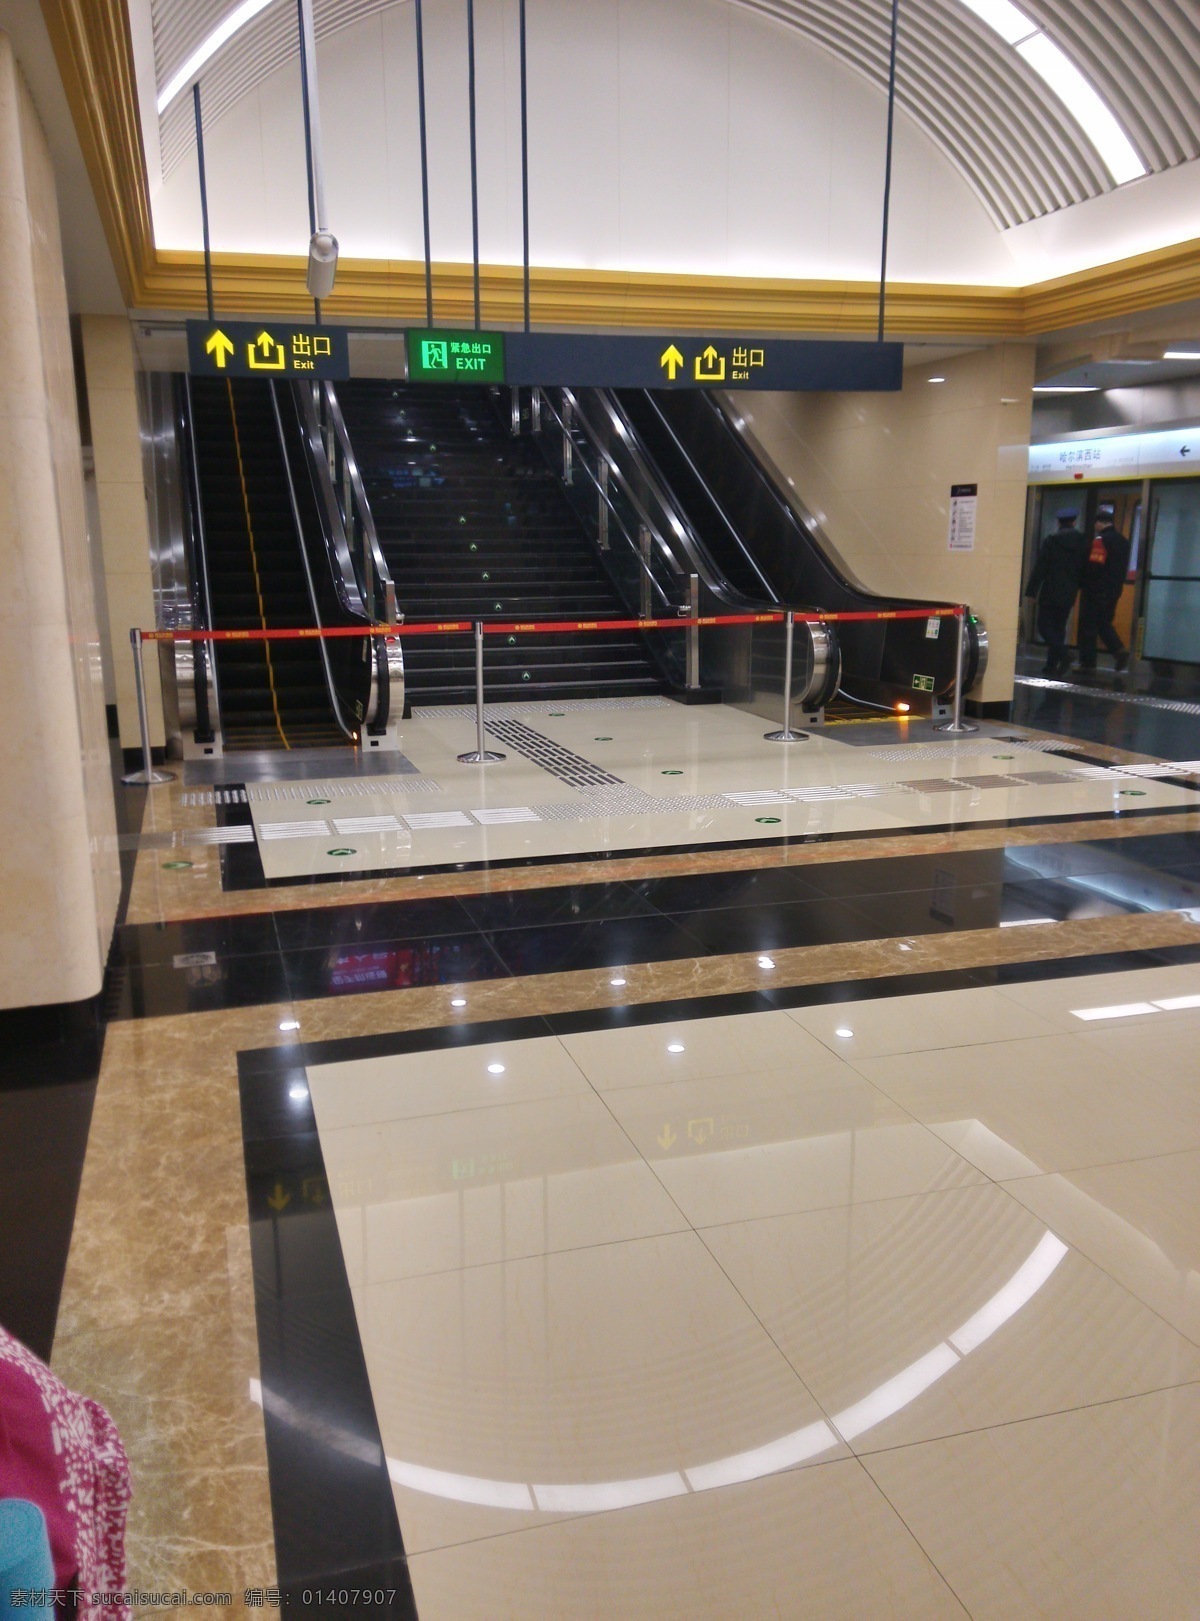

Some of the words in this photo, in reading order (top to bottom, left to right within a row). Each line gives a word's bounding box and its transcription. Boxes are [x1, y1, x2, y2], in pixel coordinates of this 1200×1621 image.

[292, 333, 332, 356] 出口
[450, 341, 492, 355] 紧急出口
[455, 357, 487, 371] EXIT
[732, 346, 765, 368] 出口
[293, 360, 315, 370] Exit
[732, 370, 750, 380] Exit
[1059, 448, 1102, 462] 哈尔滨西站
